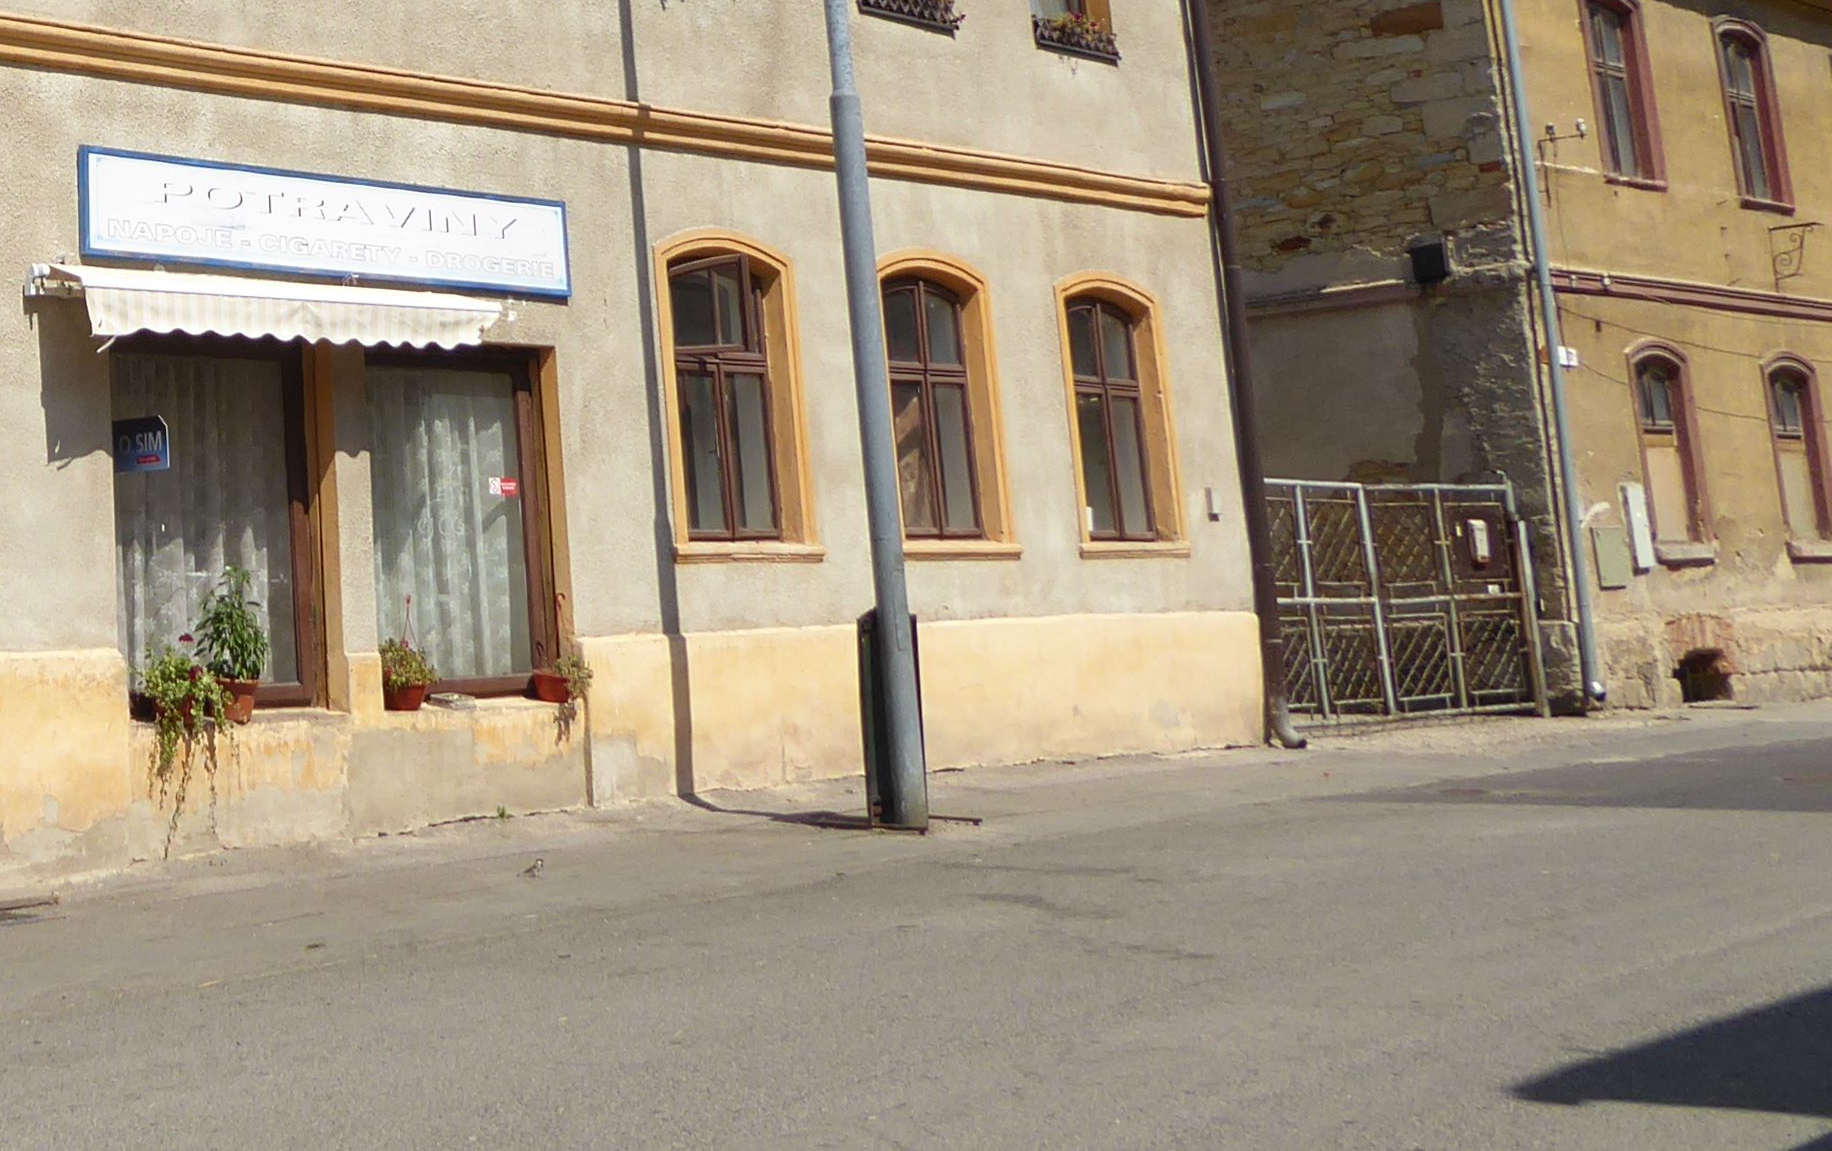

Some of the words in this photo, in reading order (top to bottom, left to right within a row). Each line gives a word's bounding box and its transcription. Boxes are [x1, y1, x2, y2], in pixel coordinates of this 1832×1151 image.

[154, 178, 518, 240] POTRAVINY
[258, 232, 402, 266] CIGARETY
[424, 248, 556, 280] DROGERIE
[135, 430, 162, 453] SIM
